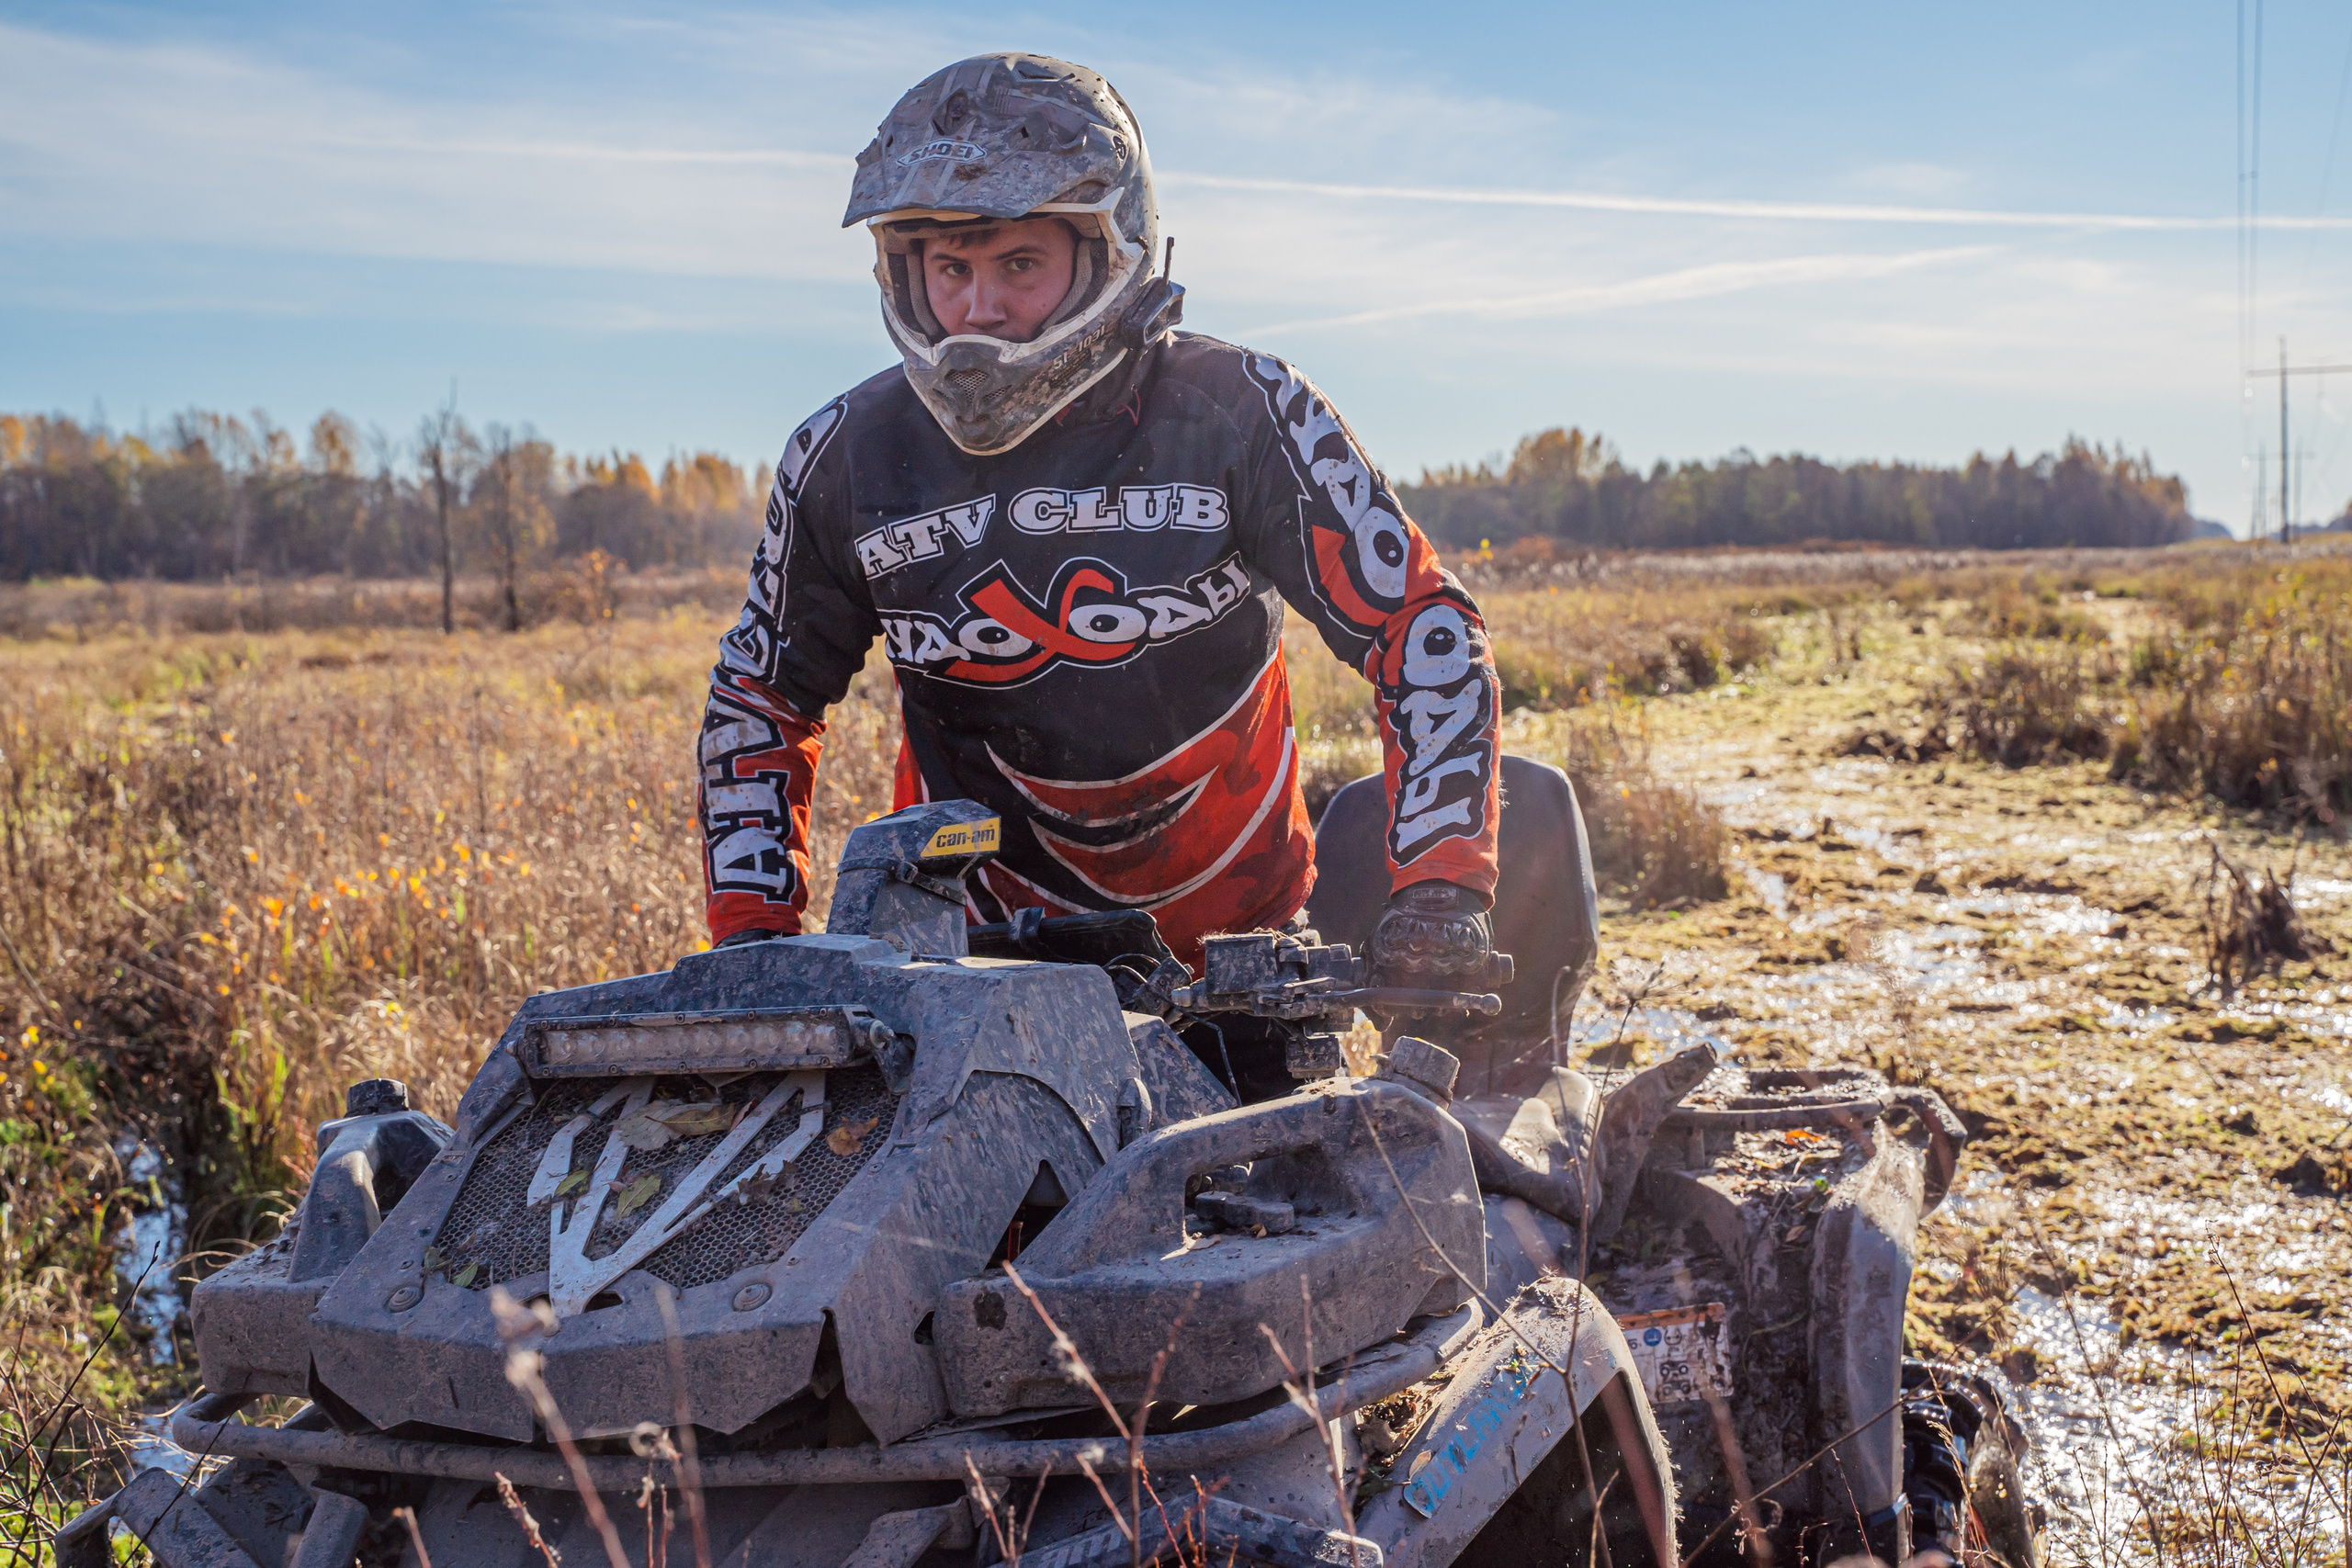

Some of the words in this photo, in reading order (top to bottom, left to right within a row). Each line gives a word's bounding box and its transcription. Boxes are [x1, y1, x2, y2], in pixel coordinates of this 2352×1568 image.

[908, 142, 975, 164] SHOEI
[855, 495, 995, 579] ATV
[1009, 484, 1228, 534] CLUB
[935, 827, 995, 849] can-am
[1404, 1355, 1540, 1513] OUTLAN
